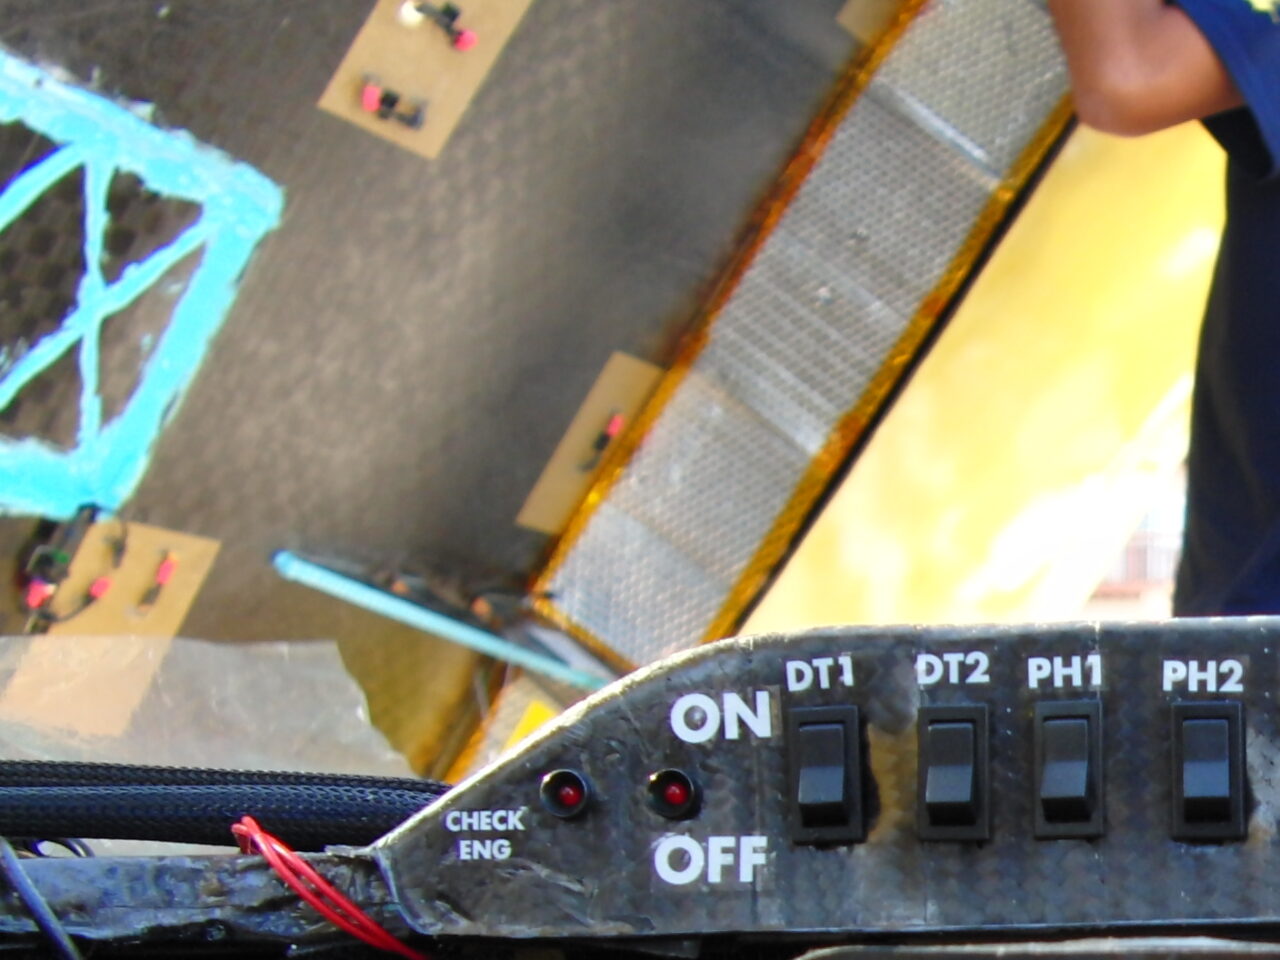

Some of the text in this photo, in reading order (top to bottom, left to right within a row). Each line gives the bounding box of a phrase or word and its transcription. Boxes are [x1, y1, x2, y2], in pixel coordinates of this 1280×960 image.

[786, 655, 855, 691] DT1
[915, 651, 990, 686] DT2
[1028, 654, 1102, 688] PH1
[1162, 660, 1244, 692] PH2
[670, 690, 772, 743] ON
[445, 807, 526, 833] CHECK
[459, 838, 512, 861] ENG
[654, 834, 768, 885] OFF
